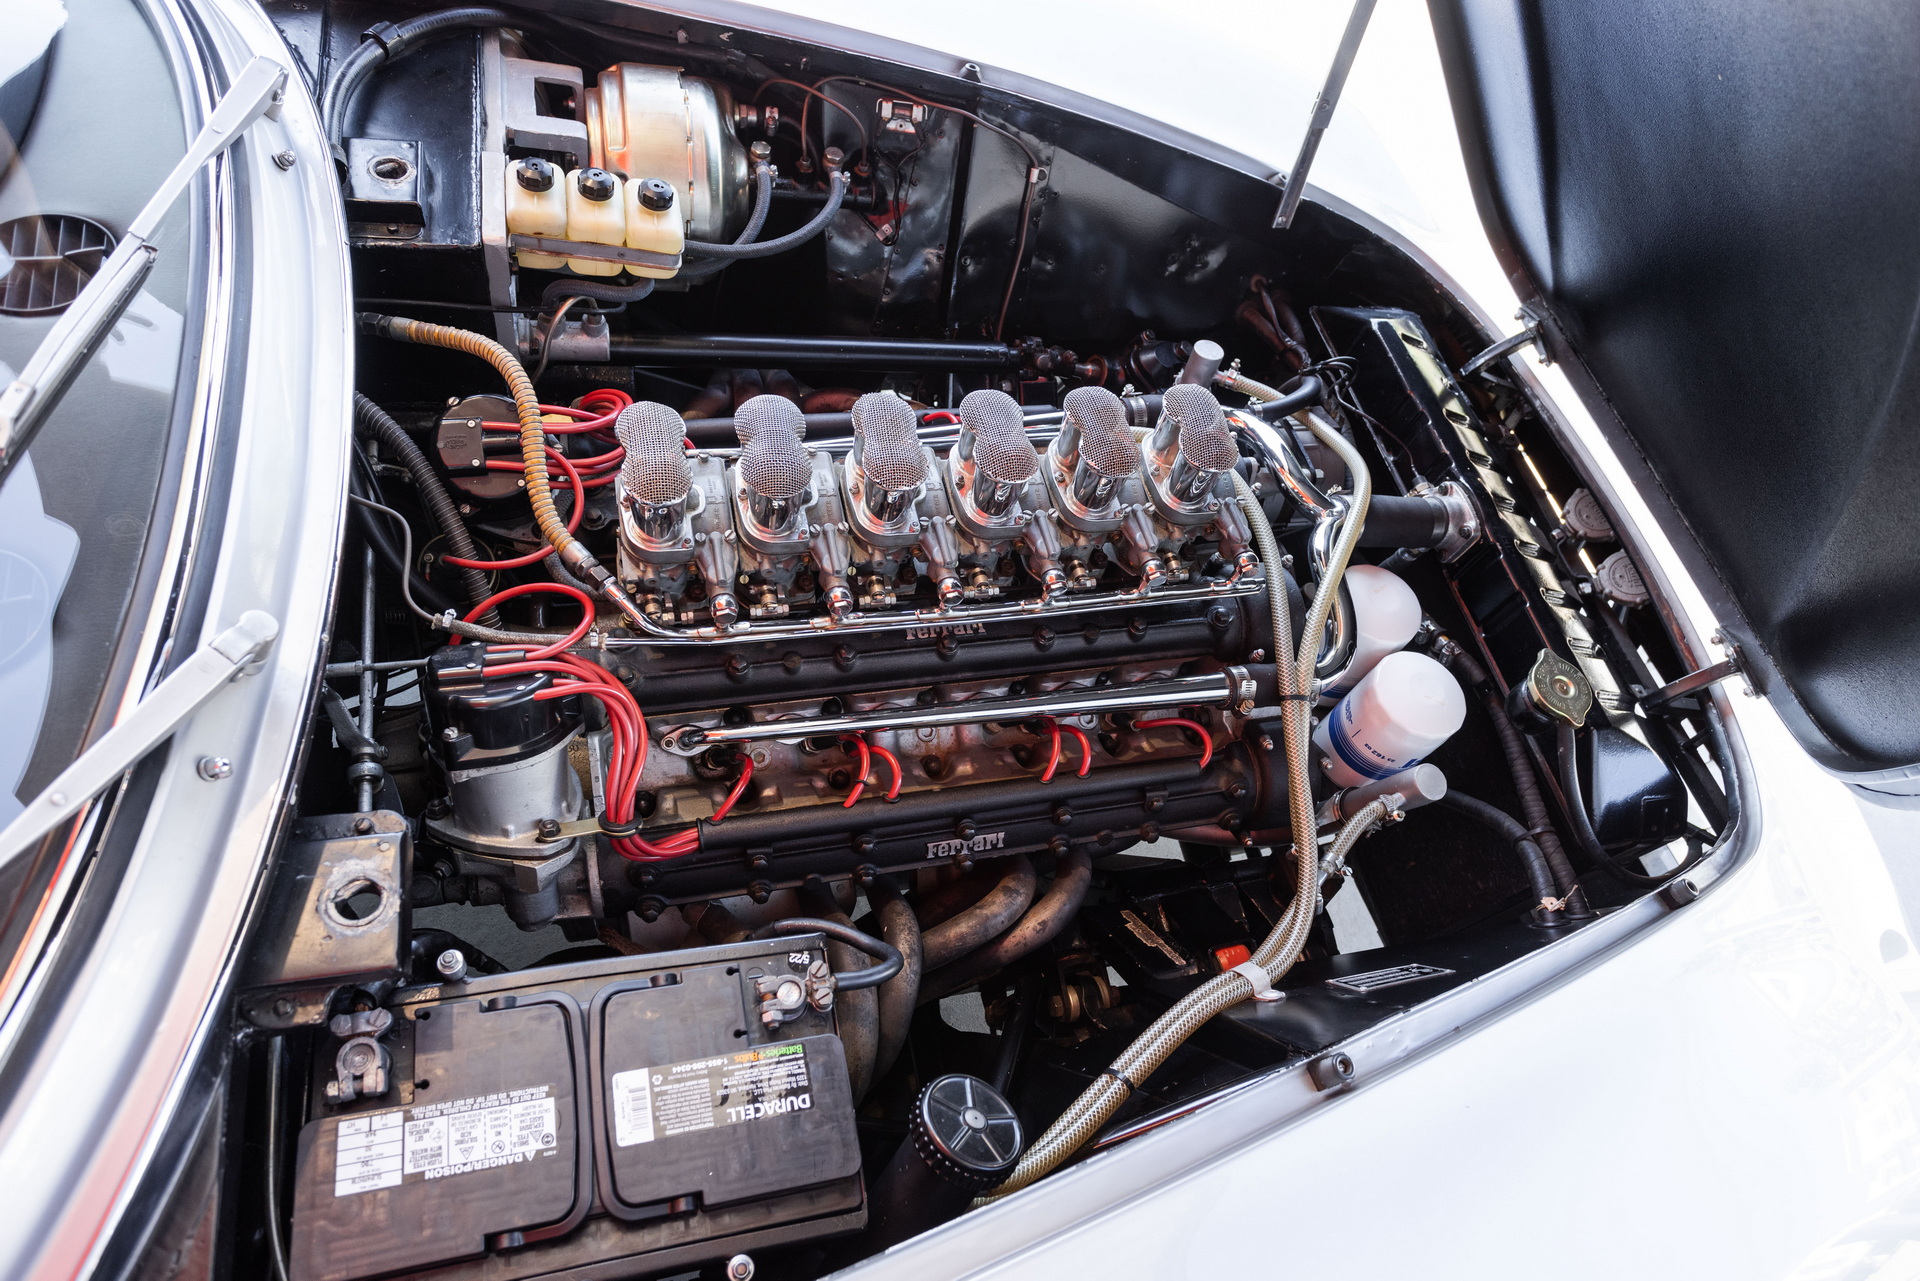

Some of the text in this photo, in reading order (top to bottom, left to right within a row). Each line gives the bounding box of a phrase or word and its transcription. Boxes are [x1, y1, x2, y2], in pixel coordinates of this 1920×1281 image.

[905, 621, 986, 641] Ferrari
[926, 833, 1005, 859] Ferrari
[789, 952, 810, 965] 5/22
[672, 1057, 728, 1073] 1-855-298-0344
[726, 1093, 812, 1123] DURACELL
[409, 1128, 430, 1136] MEDICAL
[519, 1122, 545, 1131] EXPLOSIVE
[454, 1136, 478, 1145] SULFURIC
[430, 1145, 443, 1153] WITH
[409, 1152, 443, 1162] IMMEDIATELY
[413, 1161, 426, 1169] EYES
[424, 1153, 524, 1179] DANGER/POISON
